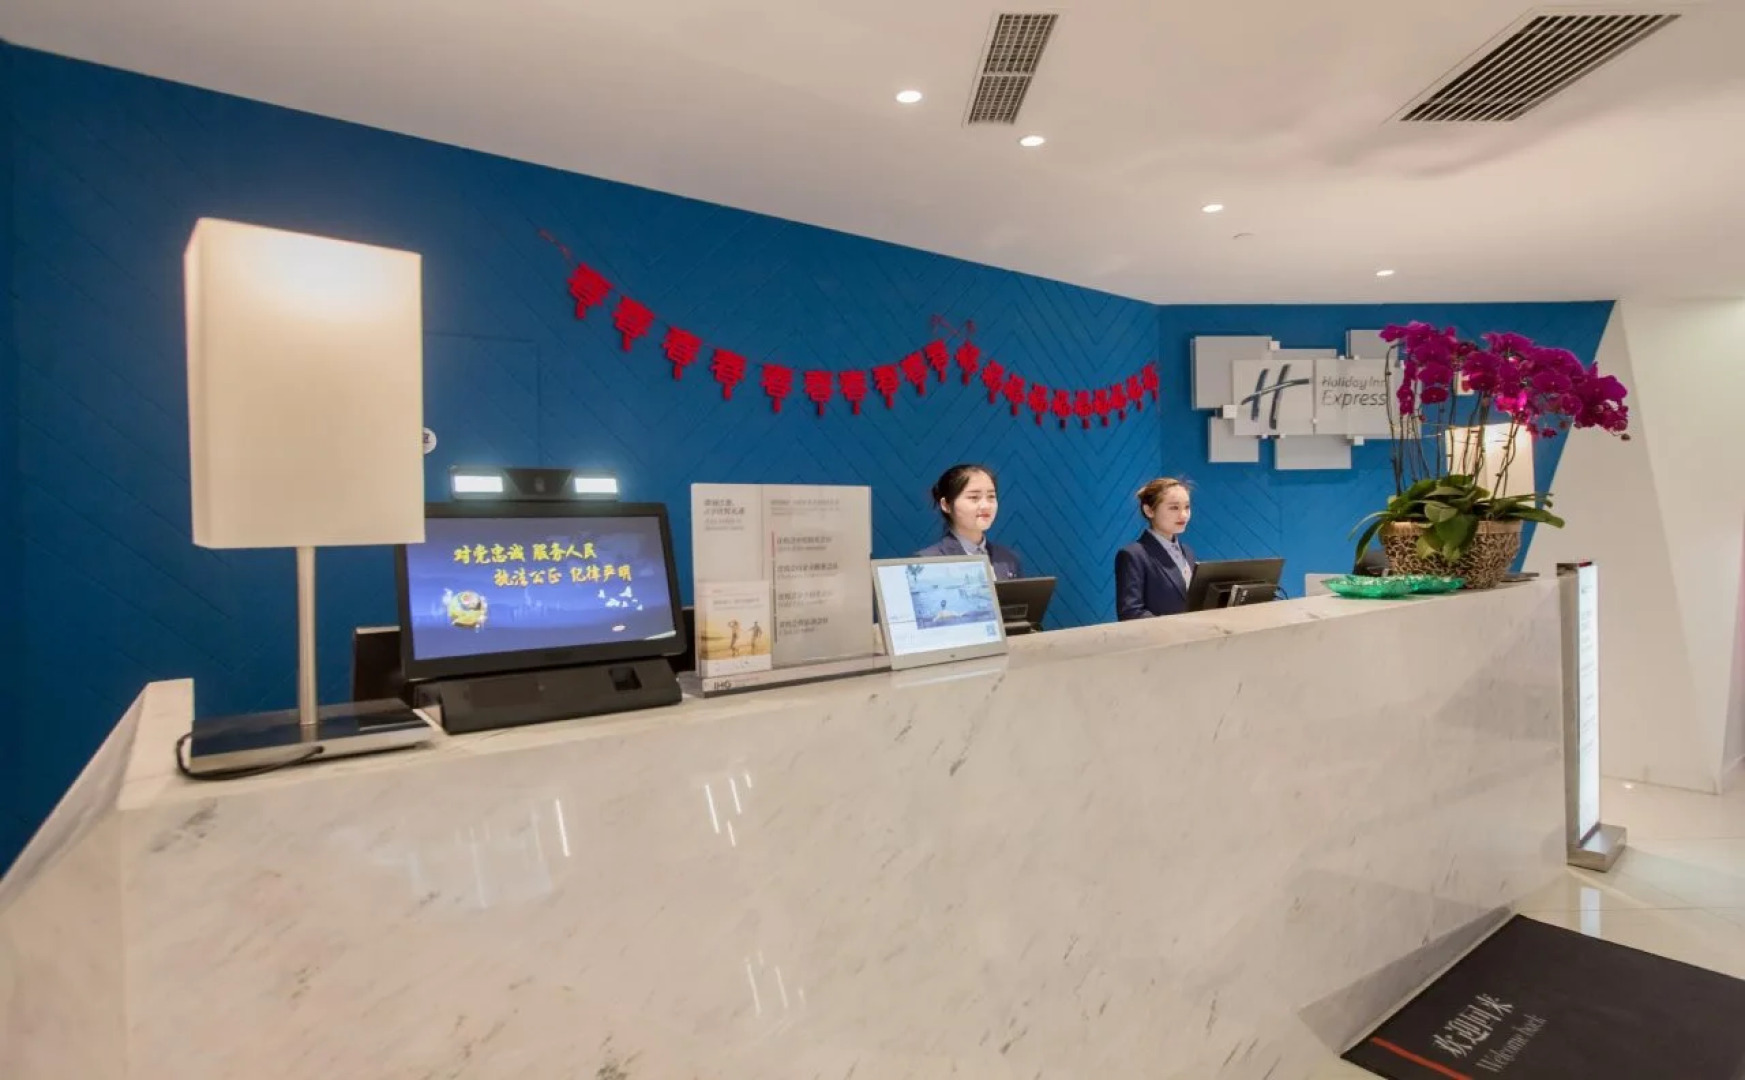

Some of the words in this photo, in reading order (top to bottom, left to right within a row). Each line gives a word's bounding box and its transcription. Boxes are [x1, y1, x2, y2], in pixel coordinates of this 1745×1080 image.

[1321, 375, 1367, 391] Holiday
[1321, 389, 1388, 410] Express
[454, 543, 526, 564] 对党忠诚
[532, 542, 598, 562] 服务人民
[494, 567, 563, 587] 执法公正
[570, 564, 632, 583] 纪律严明
[1432, 993, 1513, 1058] 欢迎回来
